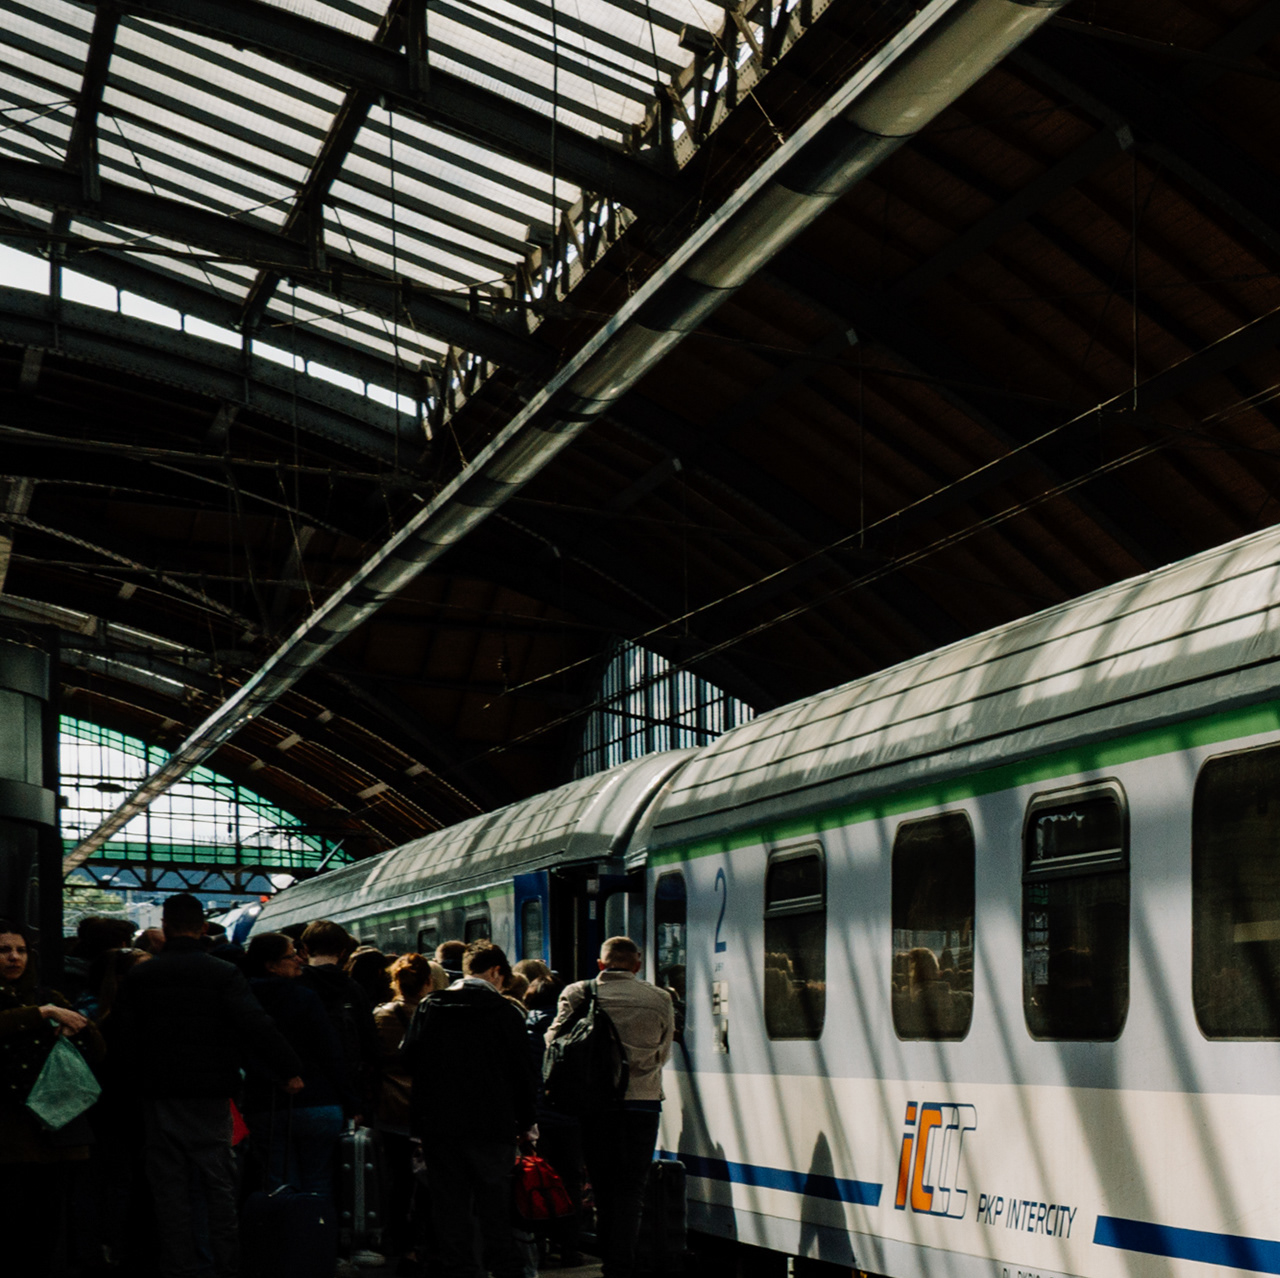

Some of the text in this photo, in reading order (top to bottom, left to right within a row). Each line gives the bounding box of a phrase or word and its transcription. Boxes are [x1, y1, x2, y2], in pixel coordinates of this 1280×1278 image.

[715, 867, 727, 953] 2
[976, 1193, 1078, 1239] PKP INTERCITY
